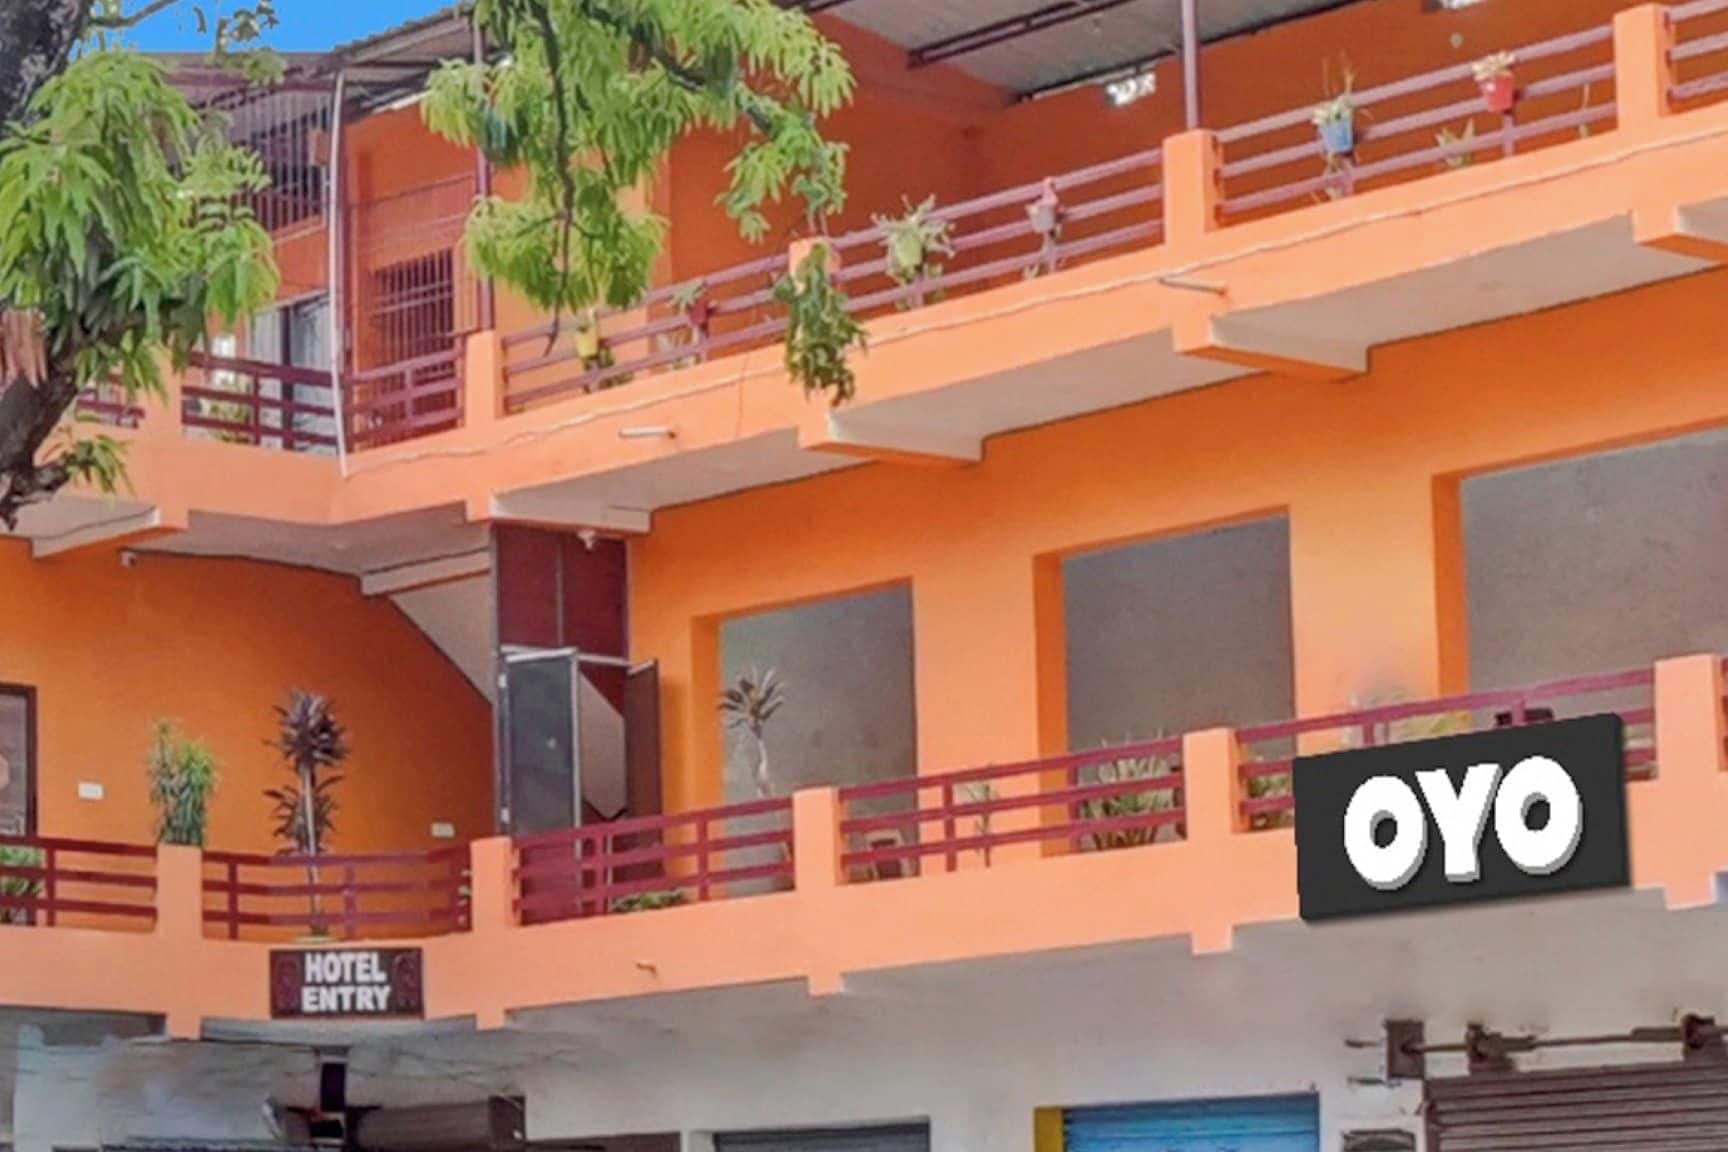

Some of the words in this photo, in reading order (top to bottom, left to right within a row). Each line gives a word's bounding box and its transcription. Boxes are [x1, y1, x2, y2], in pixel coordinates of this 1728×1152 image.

[1344, 755, 1584, 891] OYO
[304, 951, 388, 983] HOTEL
[301, 984, 391, 1012] ENTRY
